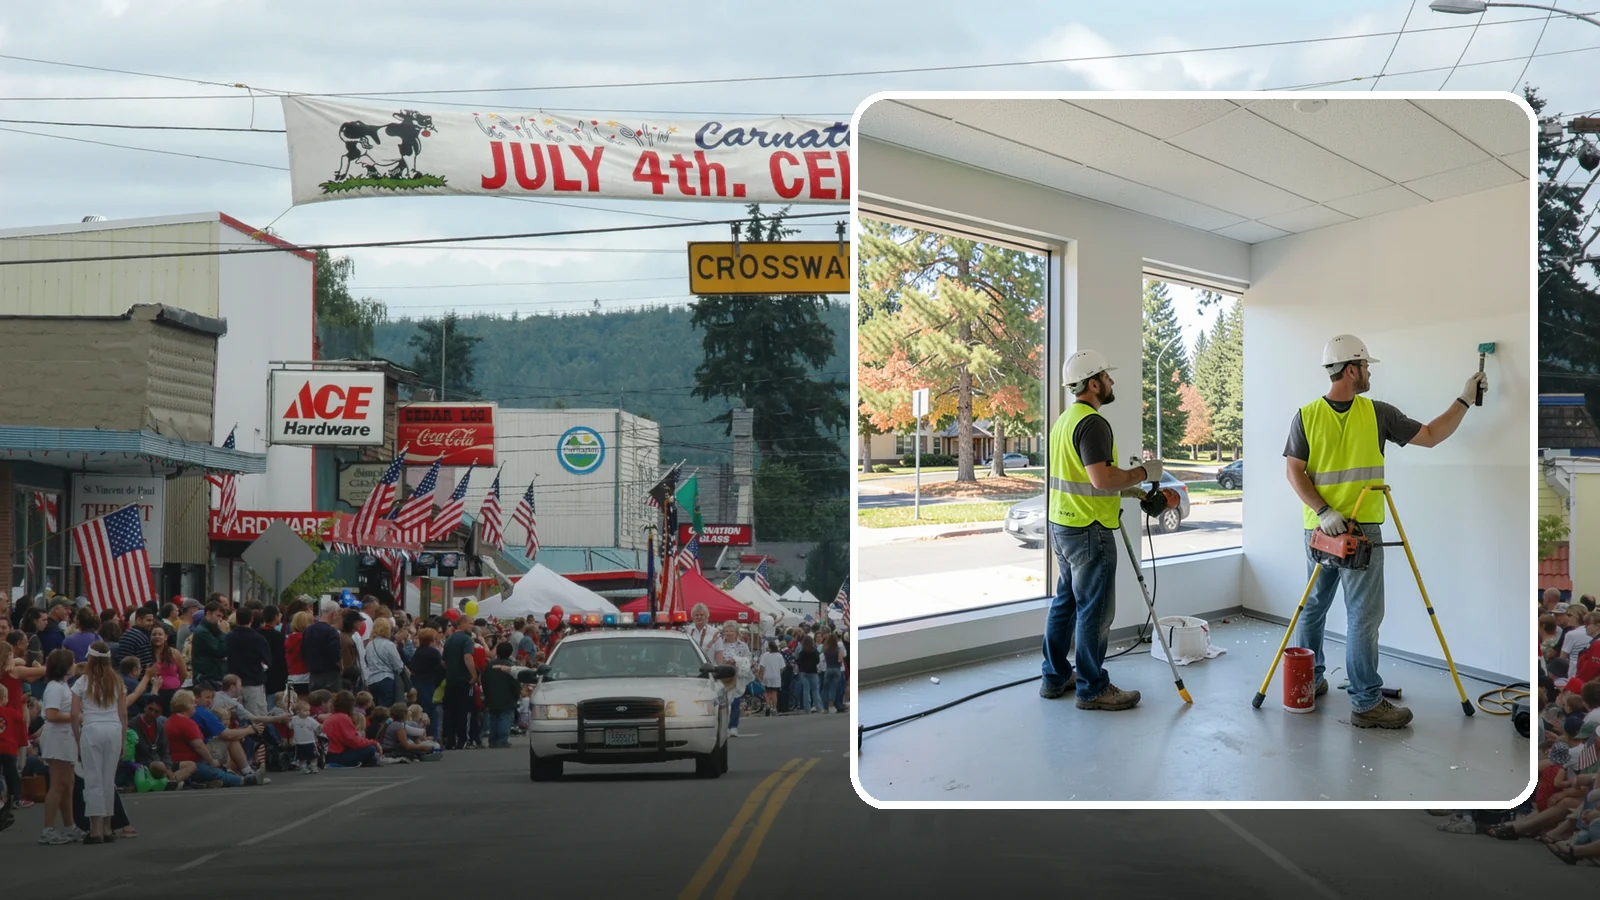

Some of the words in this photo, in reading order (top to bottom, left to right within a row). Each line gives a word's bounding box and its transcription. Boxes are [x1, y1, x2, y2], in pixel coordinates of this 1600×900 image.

[481, 140, 605, 192] JULY
[632, 150, 747, 197] 4th.
[697, 254, 850, 280] CROSSWA
[283, 380, 374, 420] ACE
[405, 409, 452, 422] CEDAR
[283, 421, 371, 436] Hardware
[416, 428, 477, 447] Coca-Cola
[95, 485, 124, 495] Vincent
[127, 485, 136, 495] de
[137, 485, 155, 495] Paul
[213, 516, 330, 535] HARDARE
[688, 526, 741, 535] CRNATION
[699, 535, 730, 543] GLASS
